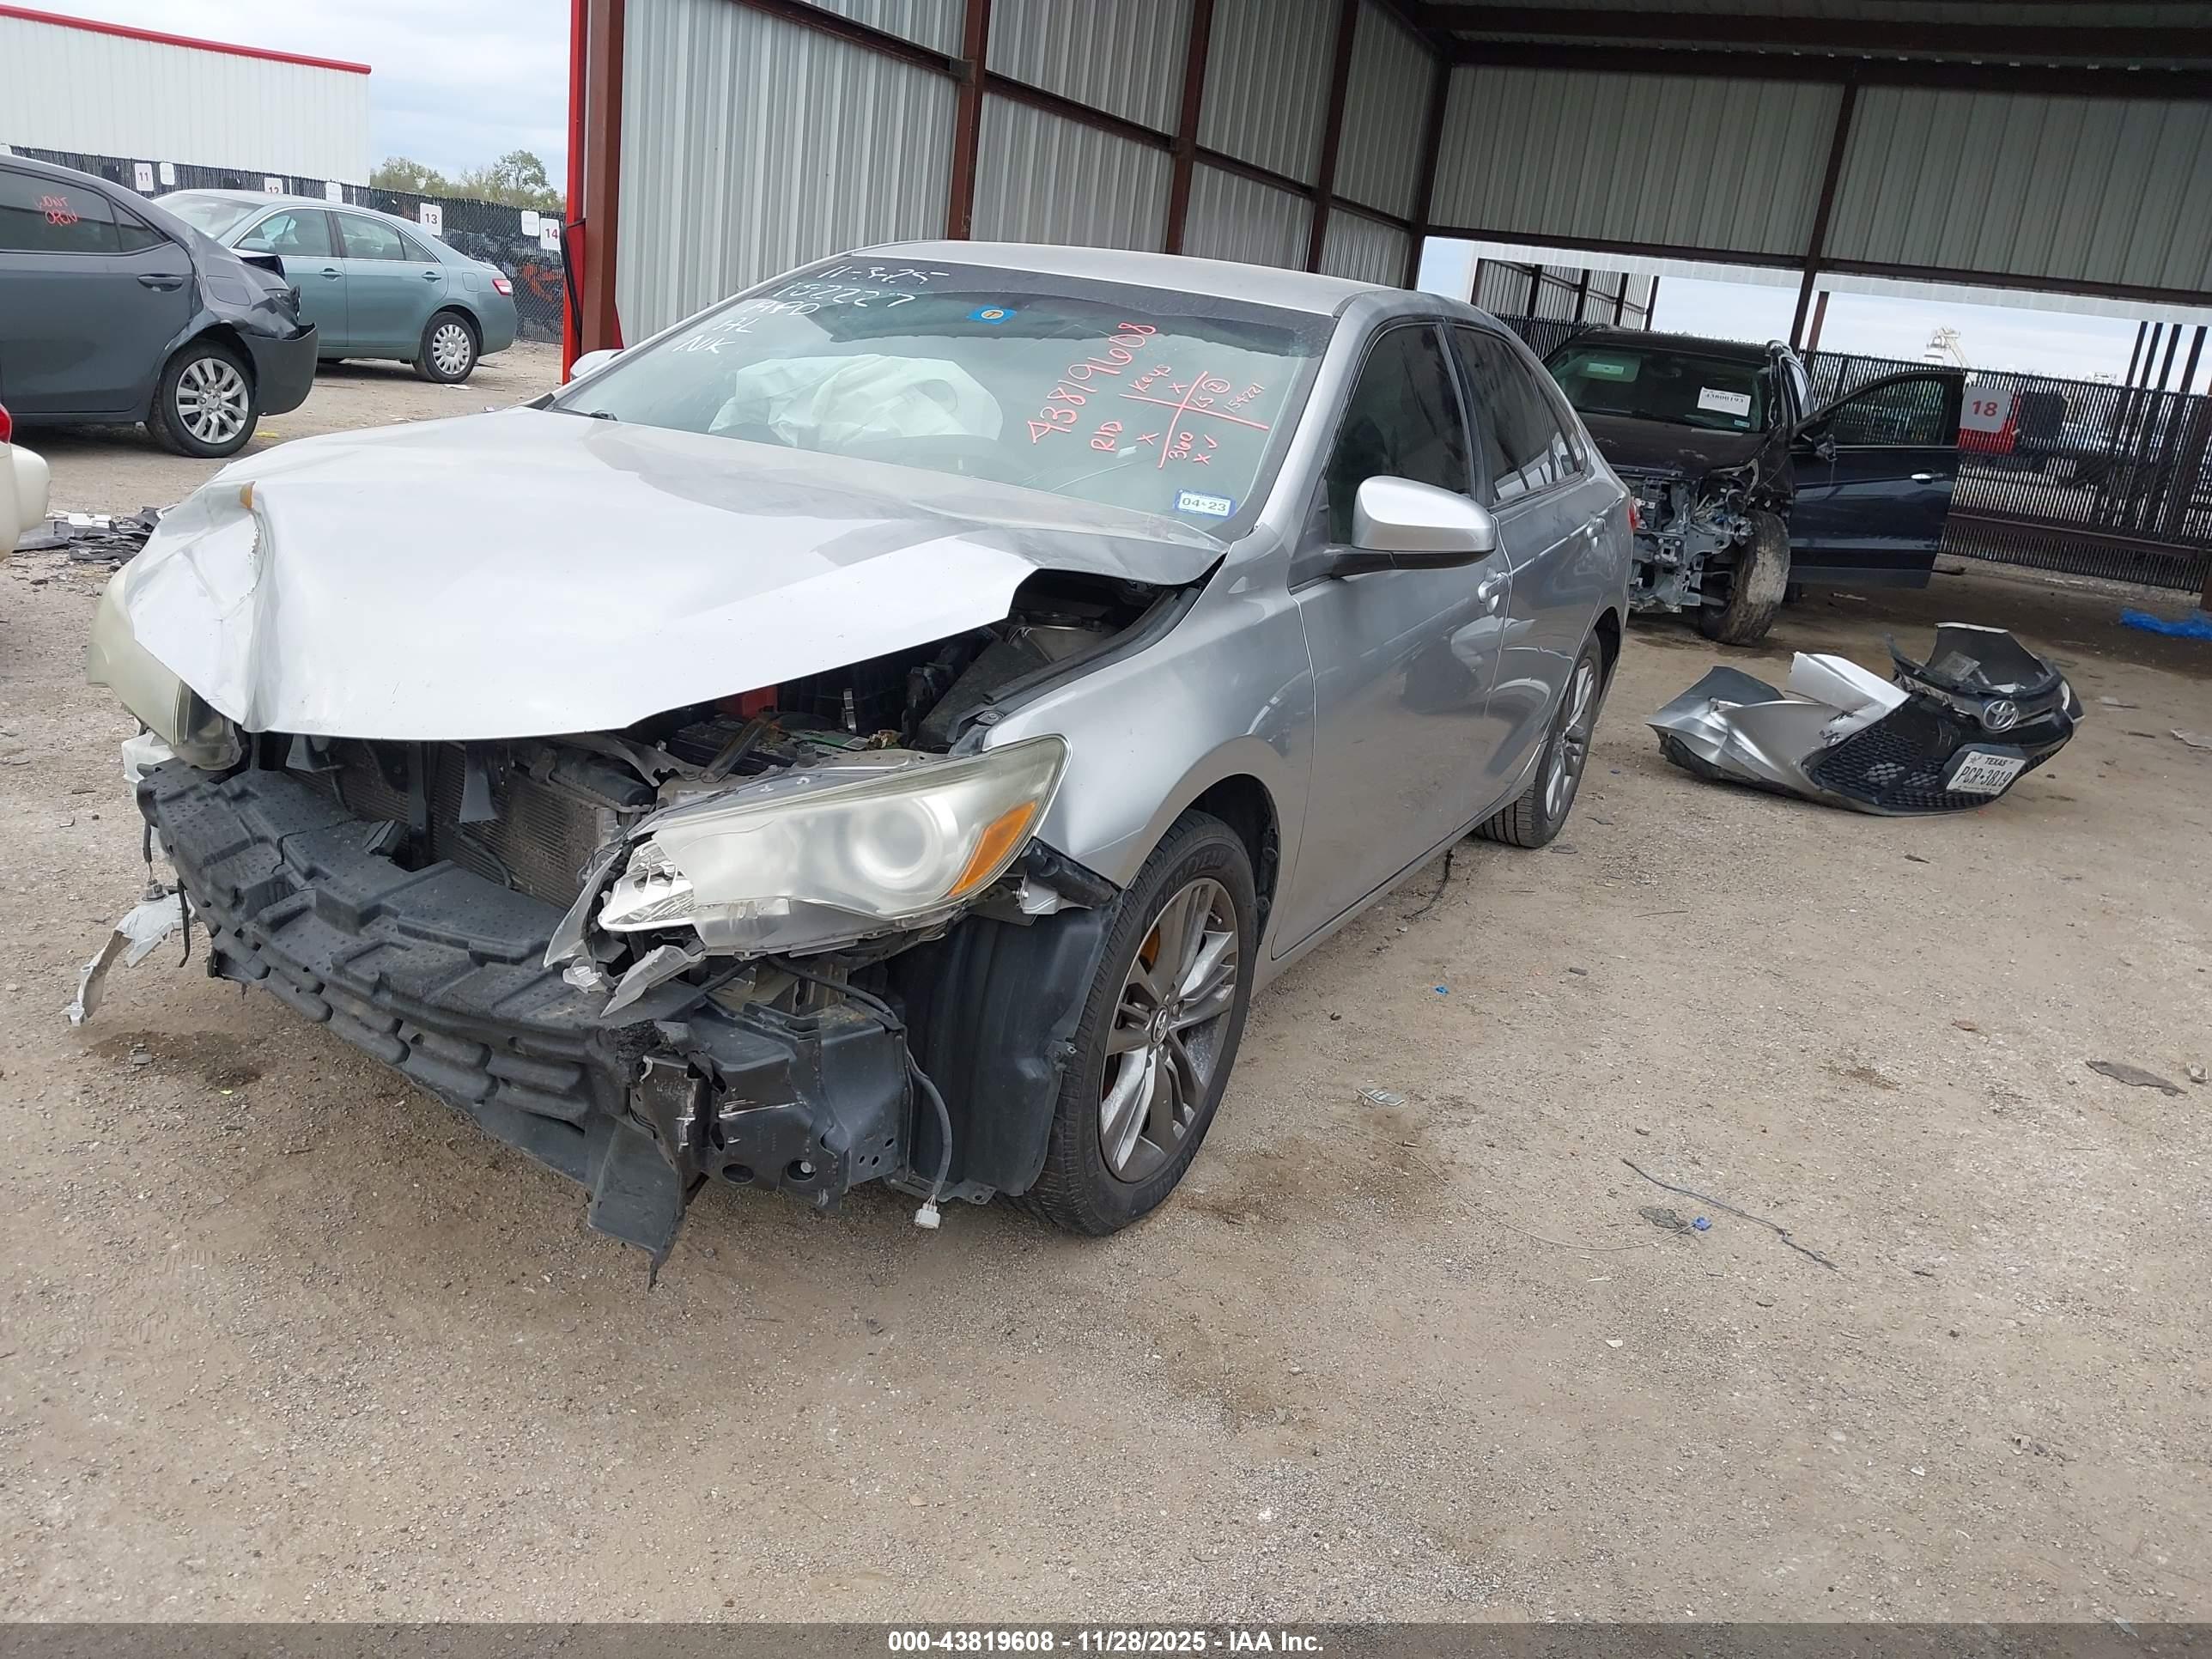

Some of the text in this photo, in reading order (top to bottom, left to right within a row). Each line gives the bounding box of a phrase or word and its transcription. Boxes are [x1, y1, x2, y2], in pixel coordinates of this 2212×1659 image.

[425, 212, 438, 225] 13
[544, 228, 558, 240] 14
[1027, 322, 1157, 445] 43819608
[1972, 399, 1999, 417] 18
[1984, 757, 2008, 768] TEXAS
